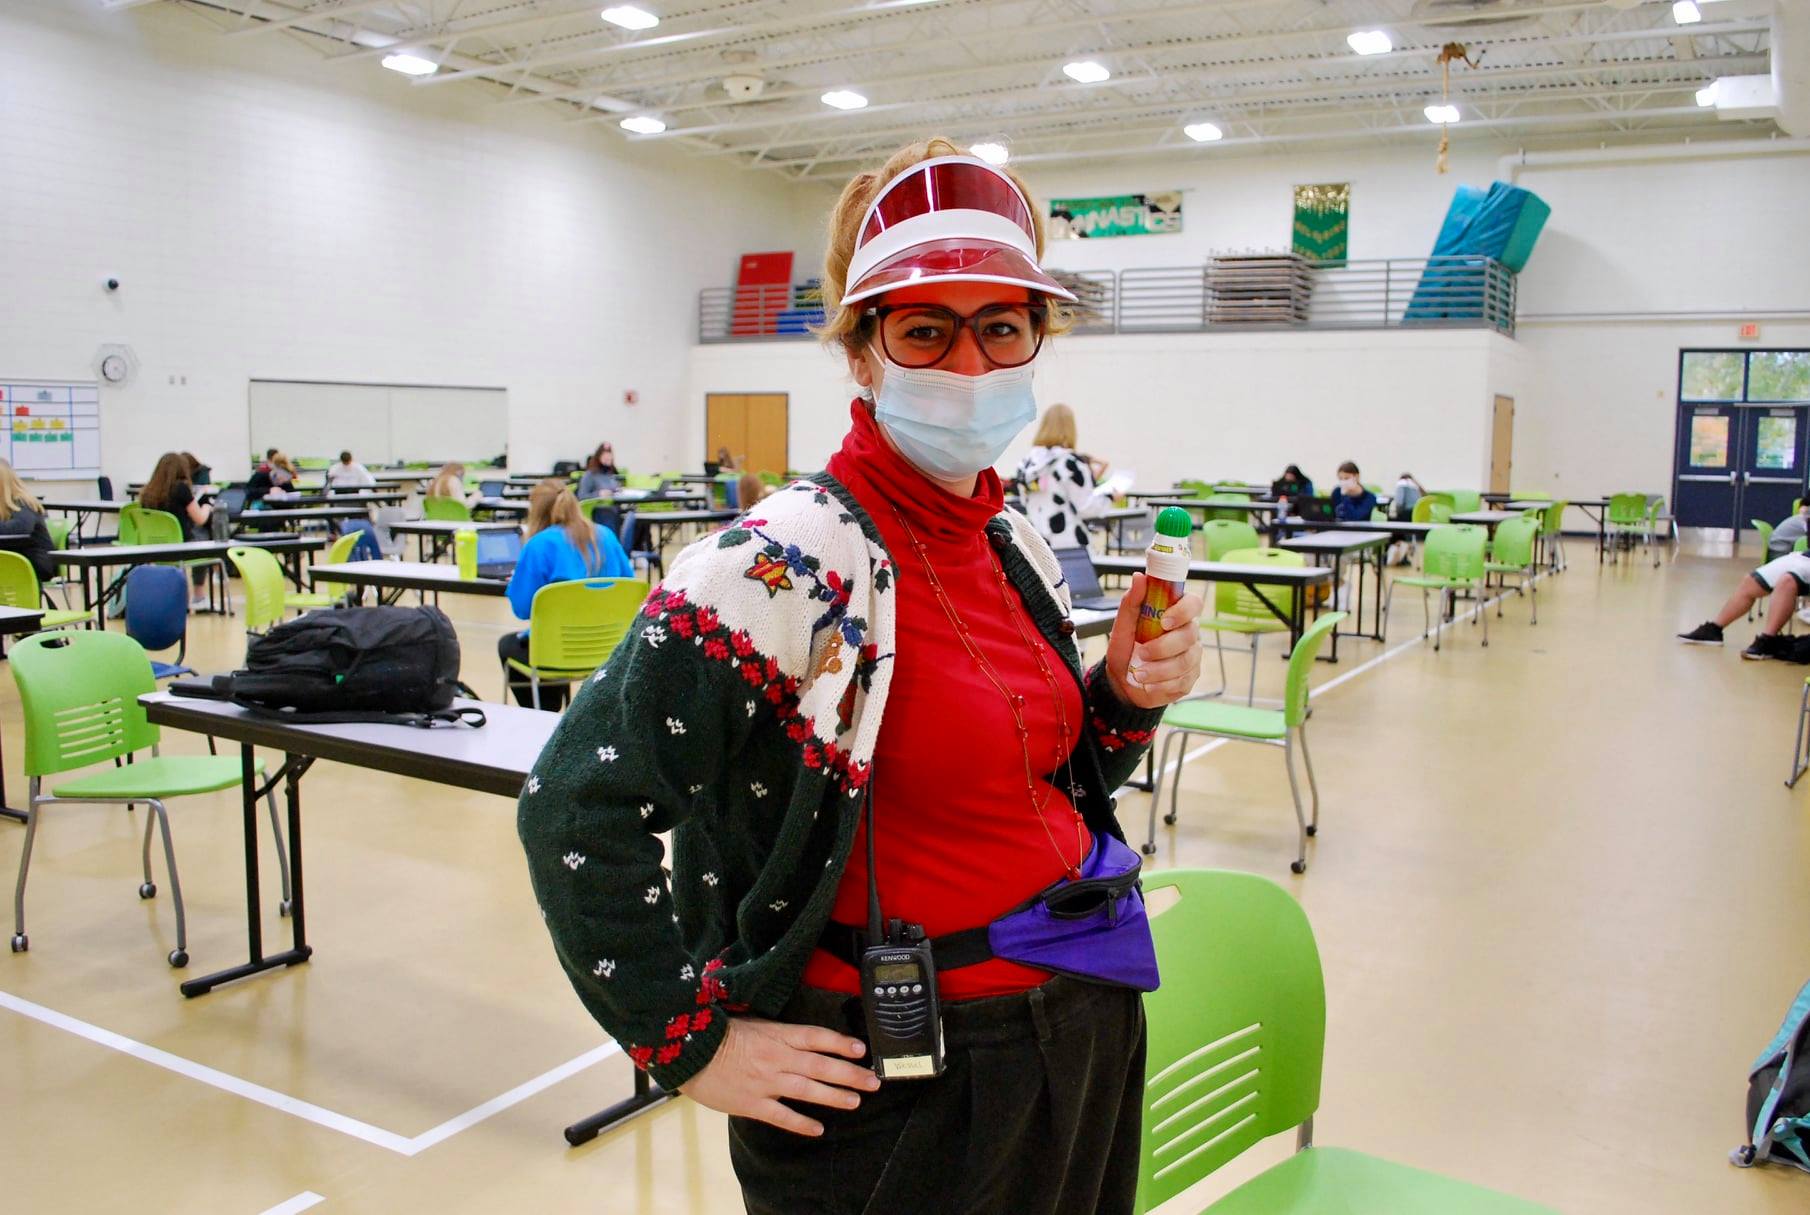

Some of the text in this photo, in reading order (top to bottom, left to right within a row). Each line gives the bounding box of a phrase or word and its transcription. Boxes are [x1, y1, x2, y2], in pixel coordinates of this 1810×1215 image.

[1050, 205, 1182, 239] NASTICS
[1142, 604, 1165, 619] BING
[880, 954, 911, 962] KENWOOD
